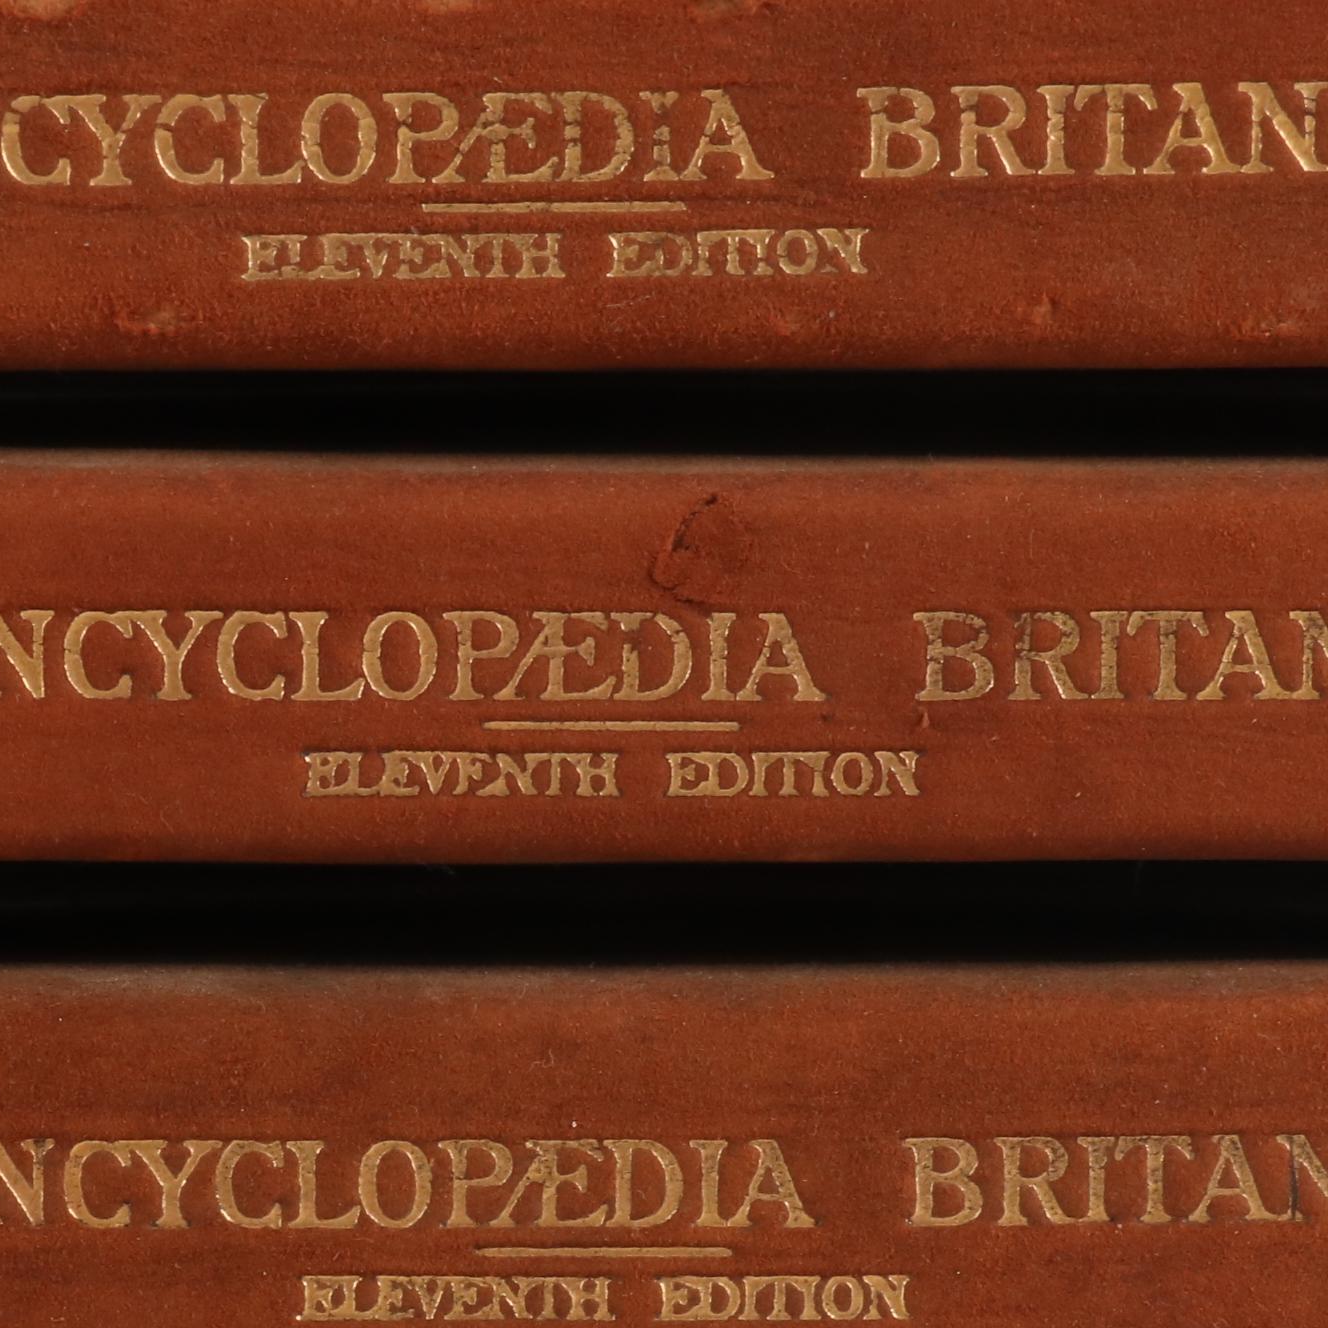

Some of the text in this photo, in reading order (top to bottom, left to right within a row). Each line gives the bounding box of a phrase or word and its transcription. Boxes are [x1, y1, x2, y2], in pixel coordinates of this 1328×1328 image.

[241, 228, 869, 281] ELEVENTH EDITION
[304, 750, 919, 796] ELEVENTH EDITION
[300, 1275, 910, 1321] ELEVENTH EDITION
